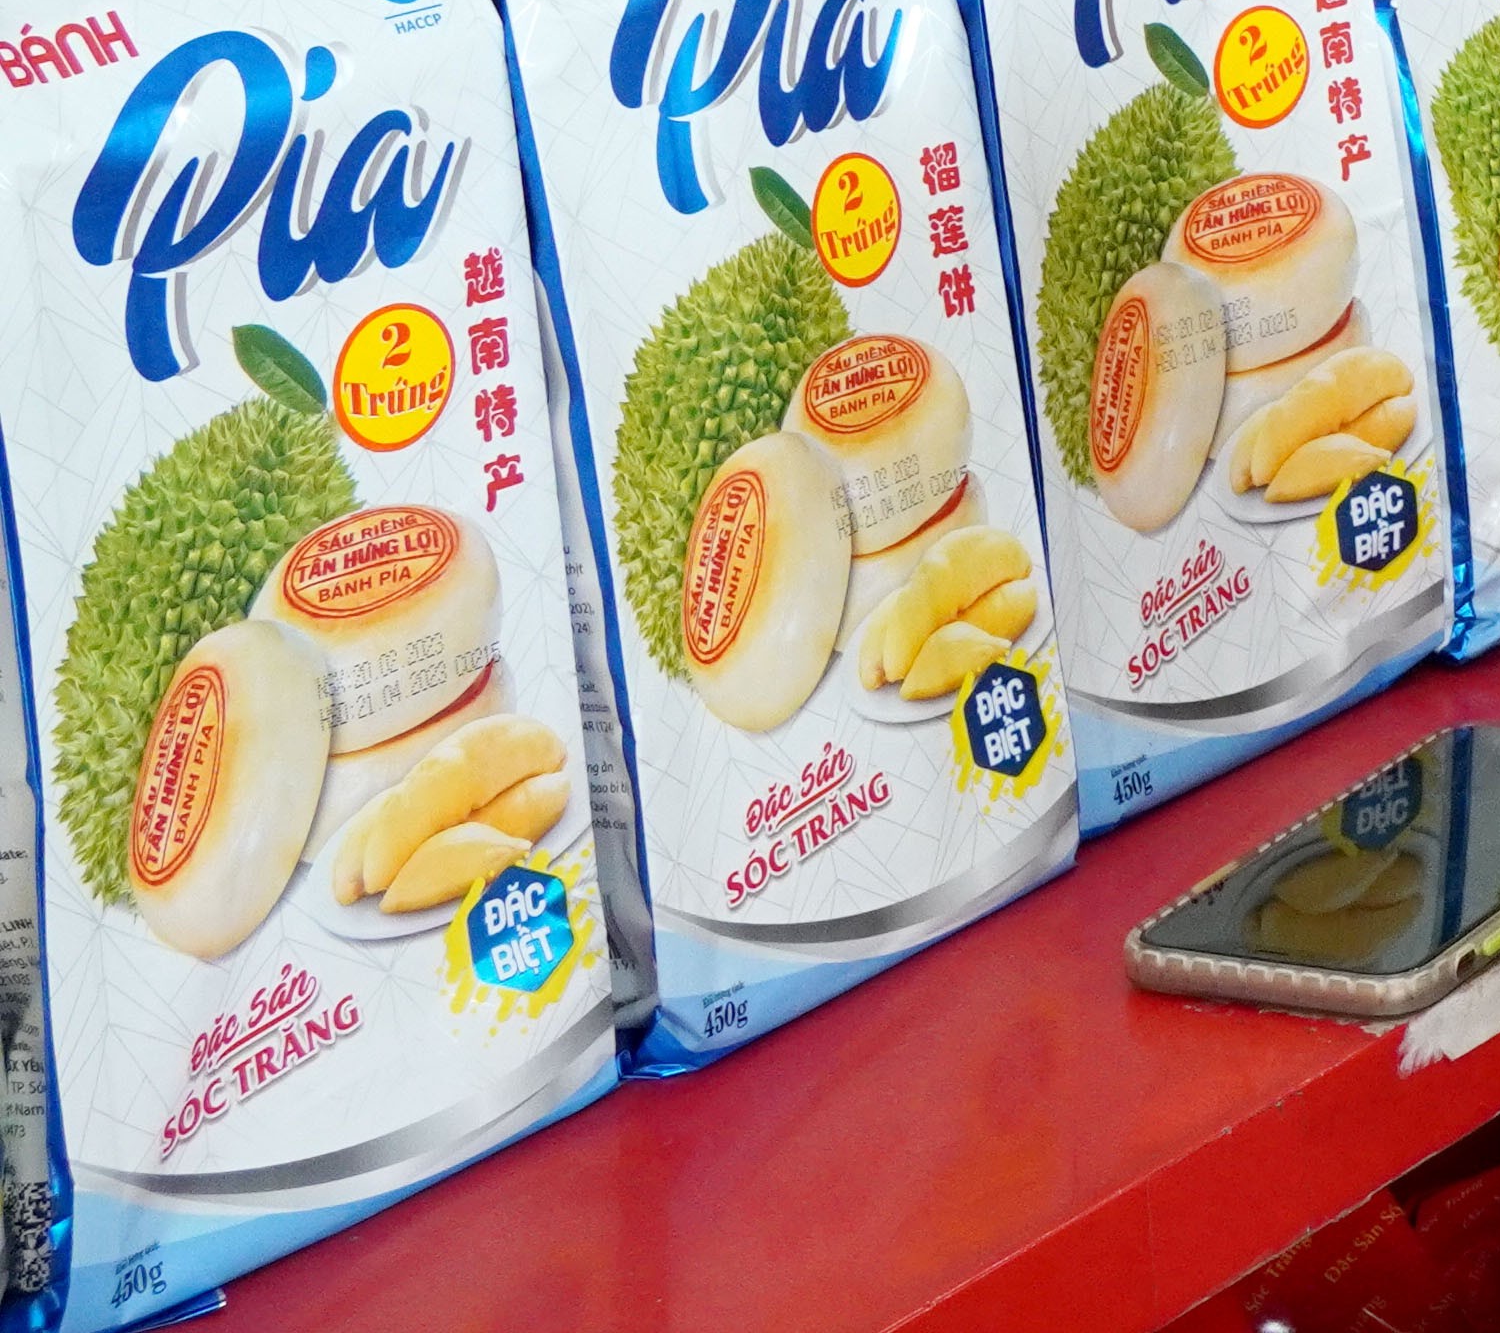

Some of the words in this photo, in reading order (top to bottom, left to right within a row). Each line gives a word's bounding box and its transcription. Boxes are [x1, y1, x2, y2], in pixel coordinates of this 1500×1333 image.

[394, 13, 443, 34] HACCP
[1239, 25, 1268, 64] 2
[0, 10, 139, 89] BÁNH
[1226, 35, 1307, 113] Trứng
[841, 170, 862, 213] 2
[819, 206, 898, 261] Trứng
[919, 141, 976, 317] 榴莲饼
[381, 322, 412, 369] 2
[344, 367, 446, 419] Trứng
[463, 247, 524, 513] 越南特产
[1349, 483, 1403, 528] ĐẶC
[1354, 520, 1404, 564] BIỆT
[297, 560, 337, 583] TÂN
[318, 574, 372, 603] BÁNH
[379, 563, 412, 585] PÍA
[1141, 578, 1176, 623] Đặc
[1128, 633, 1175, 688] SÓC
[1175, 567, 1250, 642] TRĂNG
[976, 677, 1026, 725] ĐẶC
[983, 721, 1032, 768] BIỆT
[745, 785, 794, 835] Đặc
[800, 742, 855, 794] Sản
[1112, 770, 1153, 806] 450g
[727, 841, 790, 907] SÓC
[795, 773, 891, 858] TRĂNG
[484, 881, 546, 931] ĐẶC
[492, 924, 554, 982] BIỆT
[190, 1014, 241, 1075] Đặc
[250, 963, 318, 1022] Sản
[703, 999, 749, 1039] 450g
[161, 1078, 227, 1155] SÓC
[232, 994, 360, 1102] TRĂNG
[111, 1260, 166, 1308] 450g
